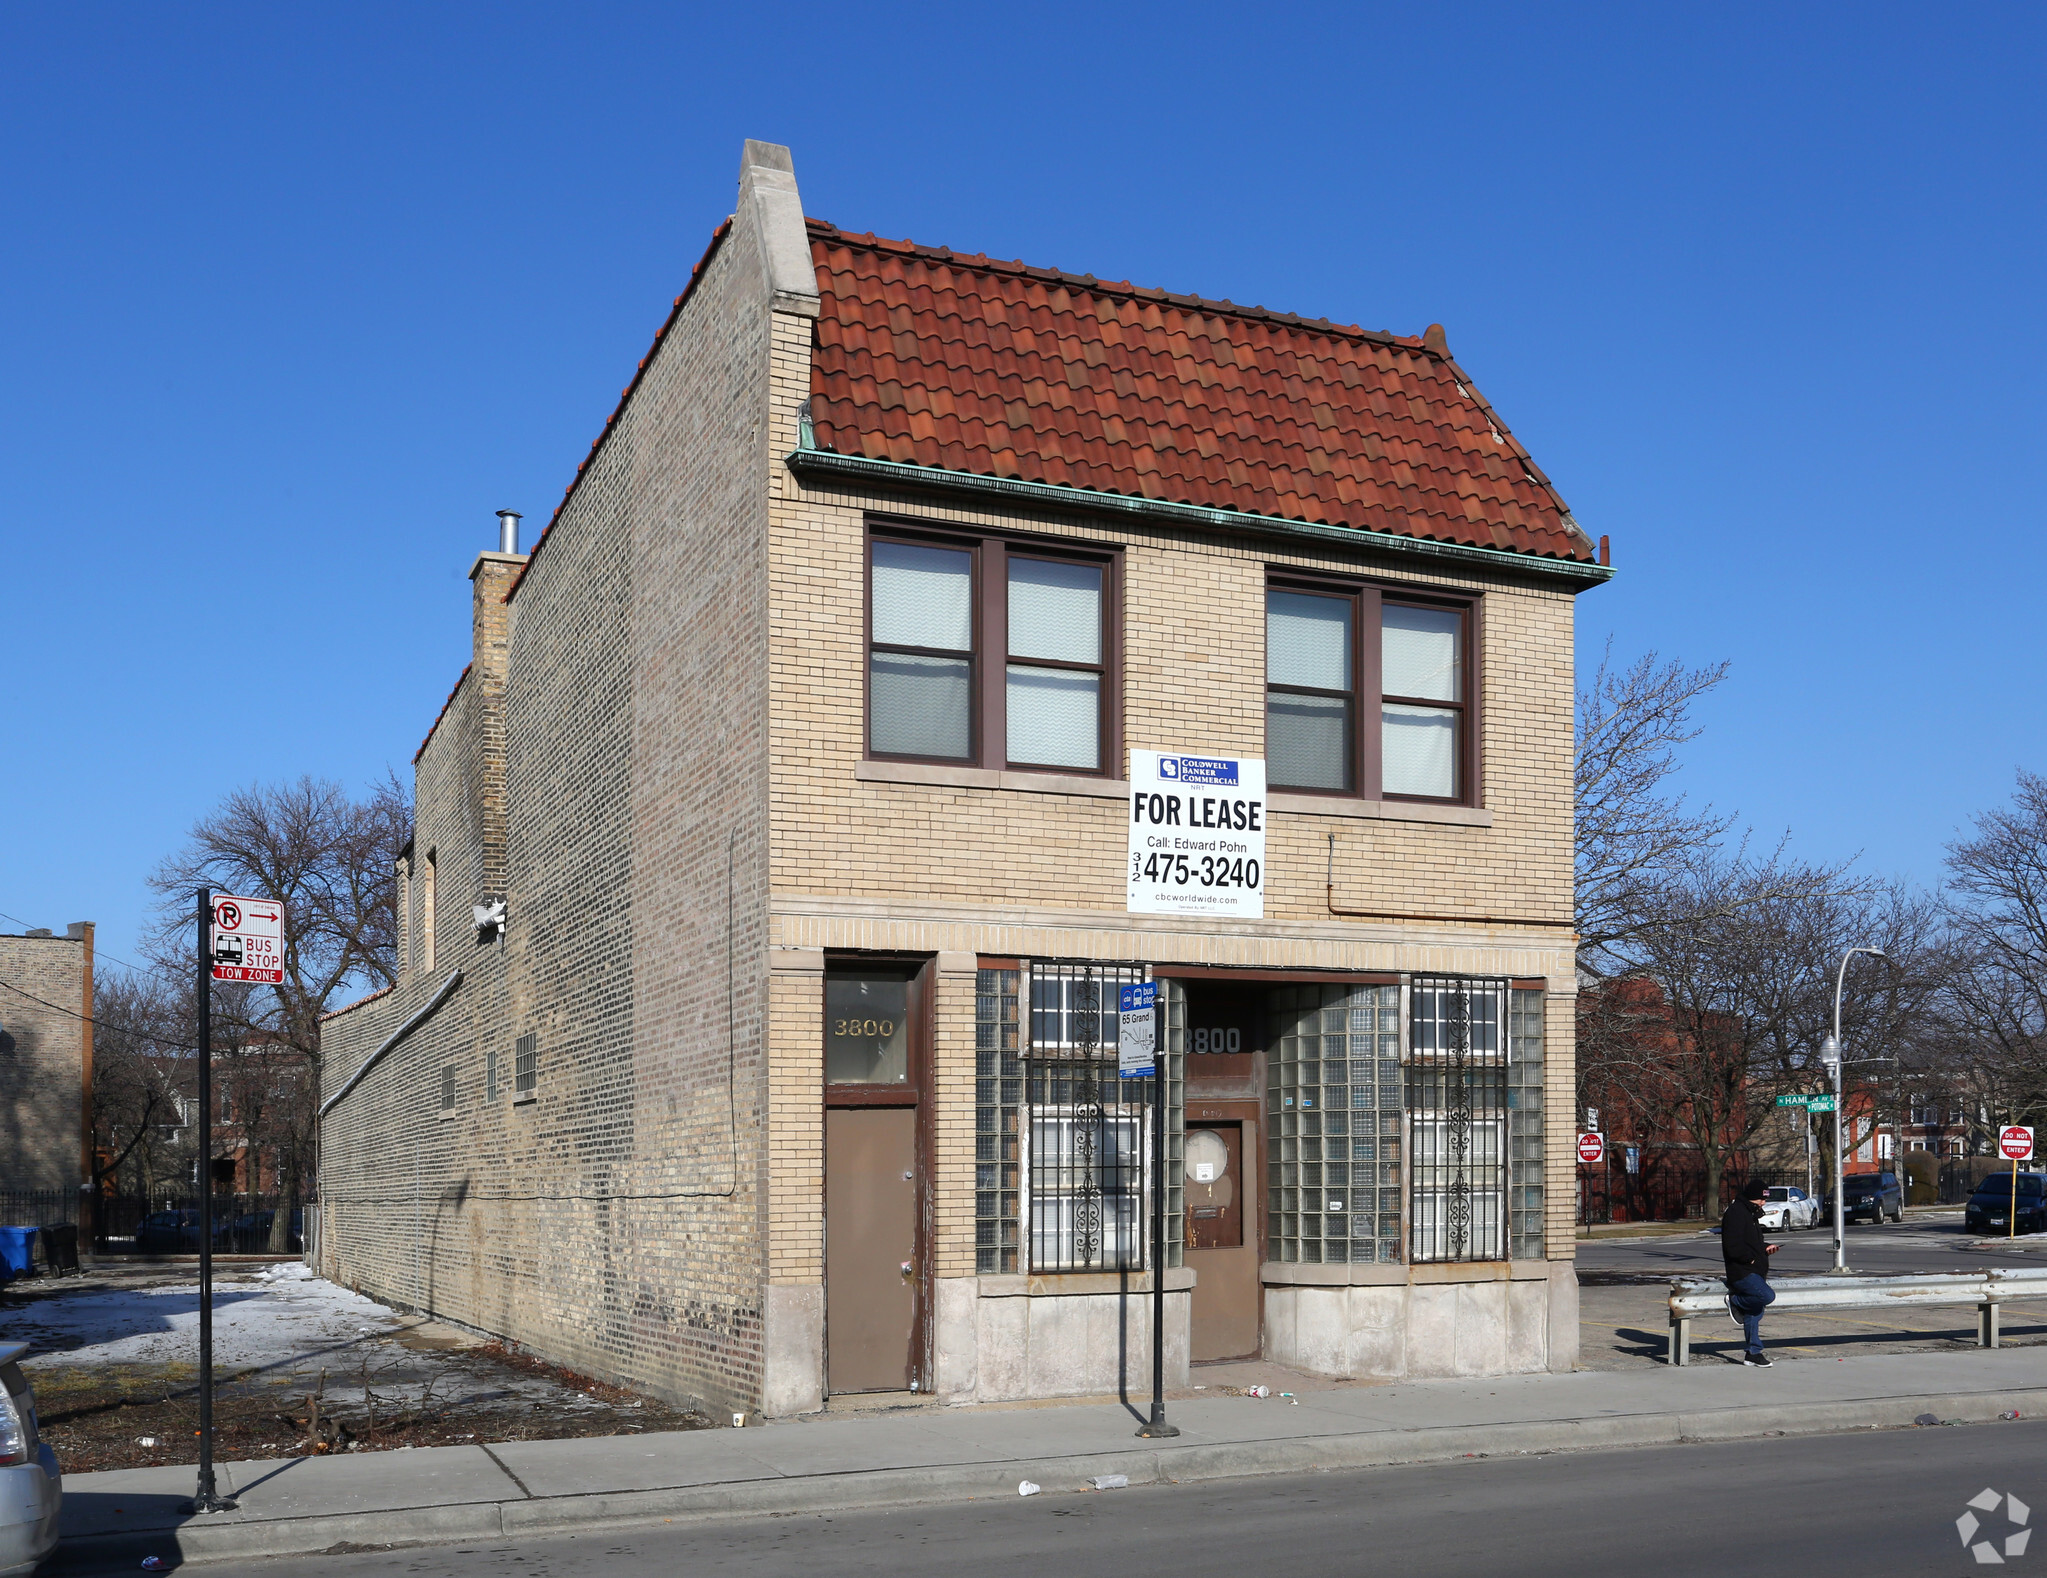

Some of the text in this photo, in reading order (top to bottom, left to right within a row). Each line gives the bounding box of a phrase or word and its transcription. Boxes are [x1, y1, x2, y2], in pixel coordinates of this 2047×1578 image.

[1182, 759, 1228, 769] COLDWELL
[1182, 767, 1216, 776] BANKER
[1182, 774, 1237, 785] COMMERCIAL
[1134, 792, 1262, 831] FOR LEASE
[1147, 835, 1247, 853] Call: Edward Pohn
[1144, 852, 1260, 889] 475-3240
[1155, 893, 1238, 905] cbcworldwide.com
[246, 938, 272, 952] BUS
[247, 954, 279, 968] STOP
[220, 967, 277, 982] TOW ZONE
[1143, 987, 1154, 996] bus
[1122, 1014, 1130, 1025] 65
[1132, 1012, 1149, 1024] Grand
[834, 1019, 894, 1037] 3800
